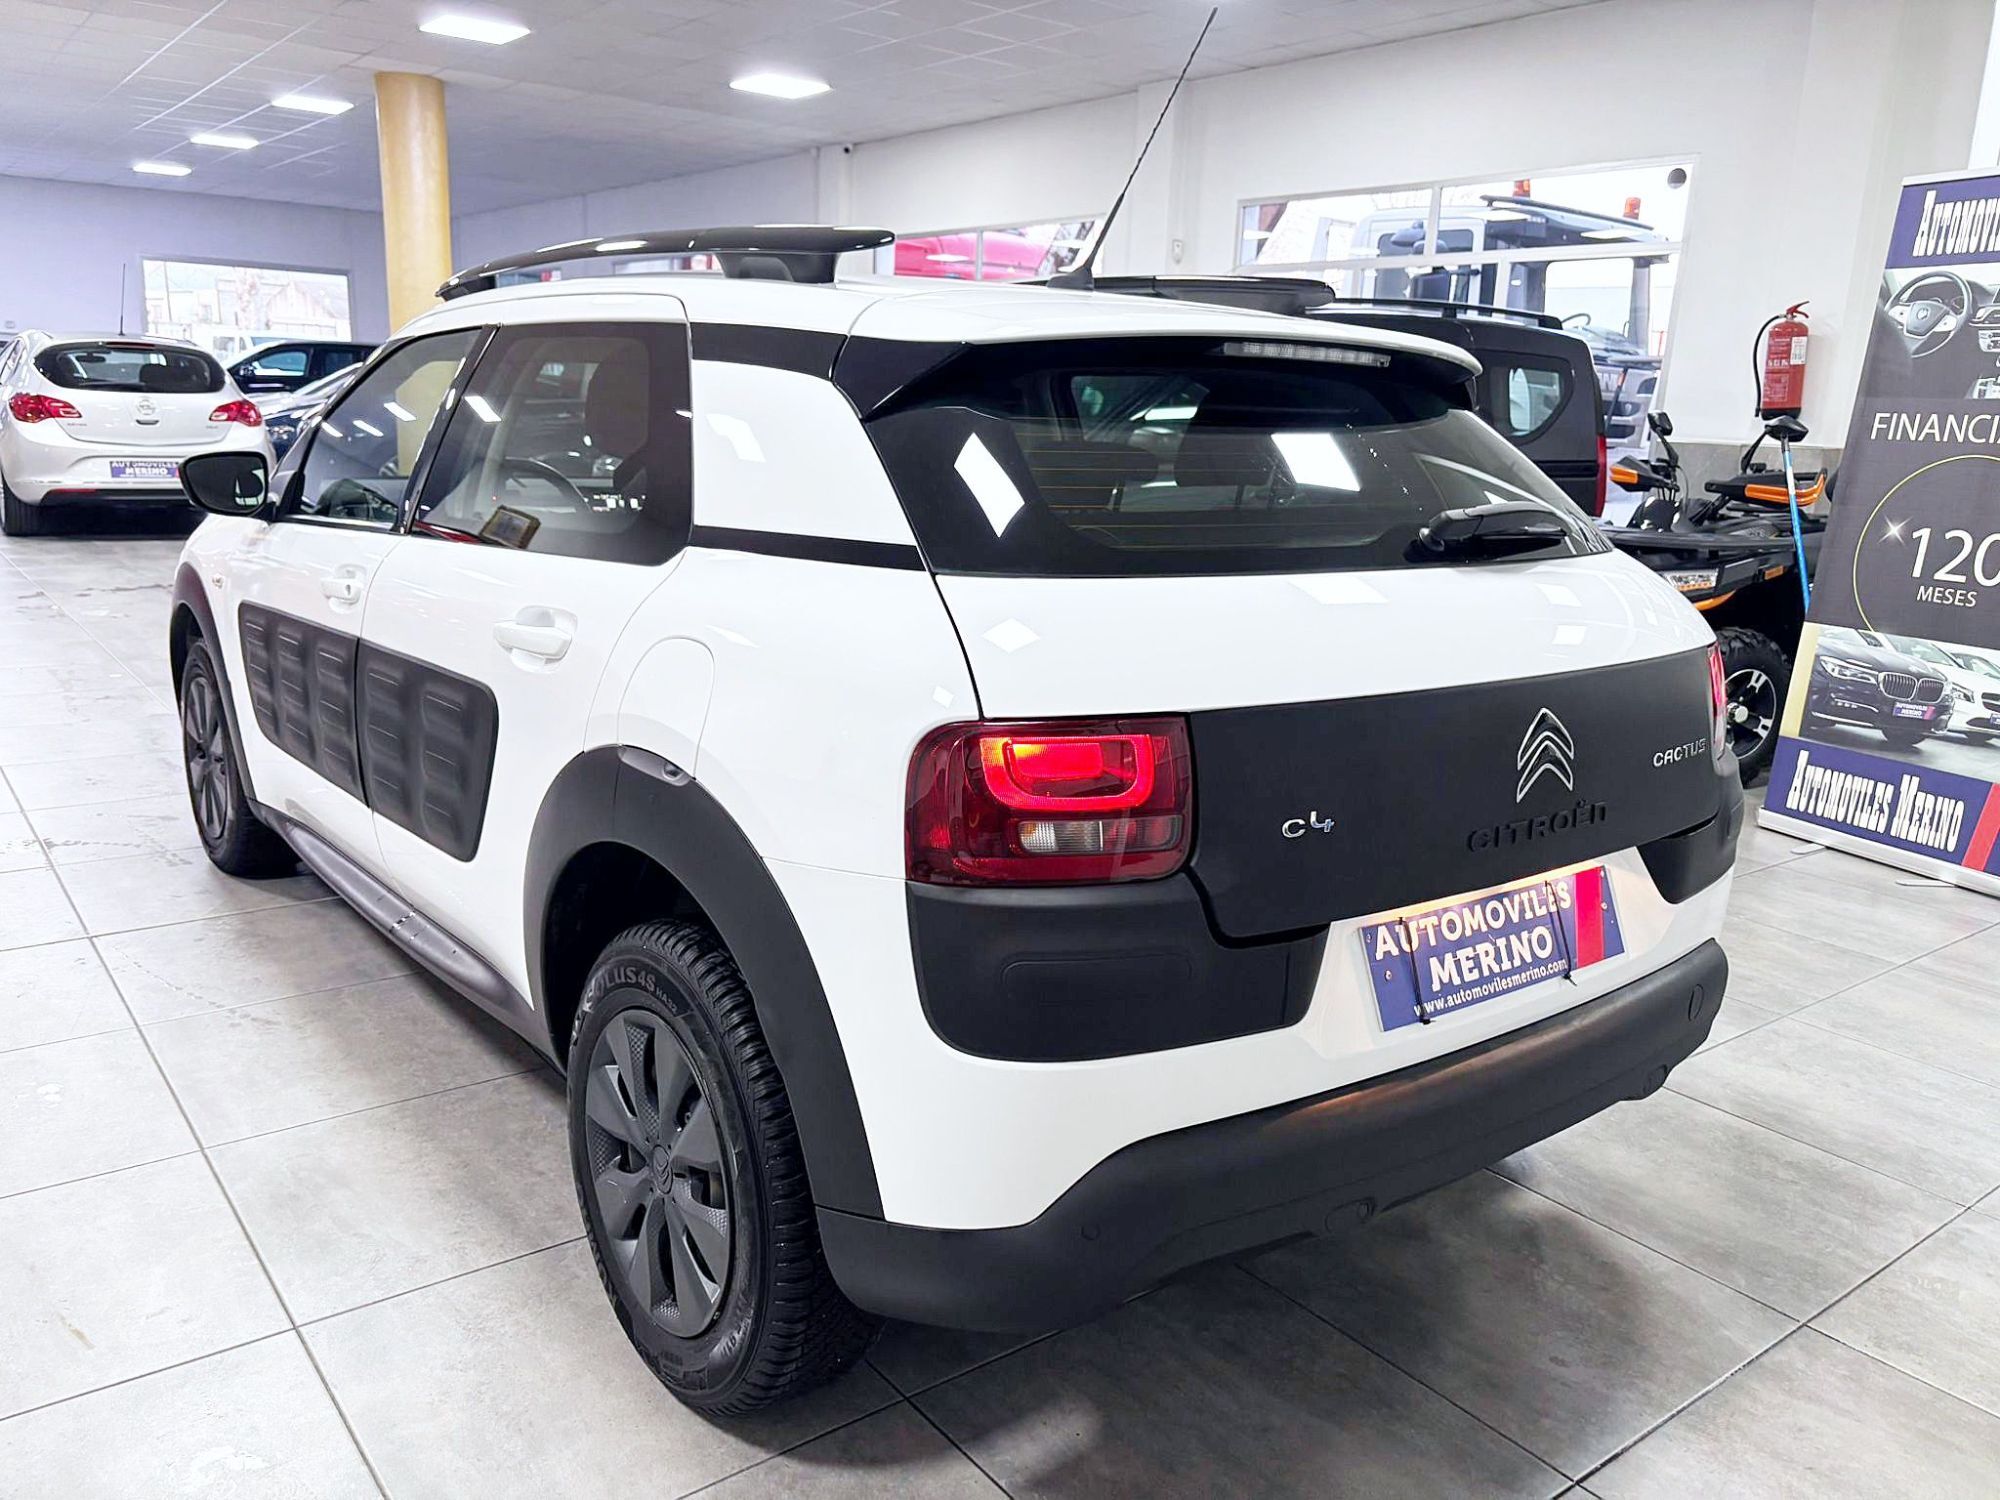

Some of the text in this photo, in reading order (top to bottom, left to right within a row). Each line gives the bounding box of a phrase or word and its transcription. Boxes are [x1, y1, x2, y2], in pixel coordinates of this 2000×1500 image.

[1870, 412, 2000, 444] FINANCI
[125, 467, 168, 475] MERINO
[1916, 586, 1978, 608] MESES
[1652, 738, 1707, 768] CACTUS
[1785, 749, 1965, 853] AUTOMOVILES MERINO
[1281, 810, 1335, 838] C4
[1375, 880, 1572, 961] AUTOMOVILES
[1429, 925, 1554, 992] MERINO
